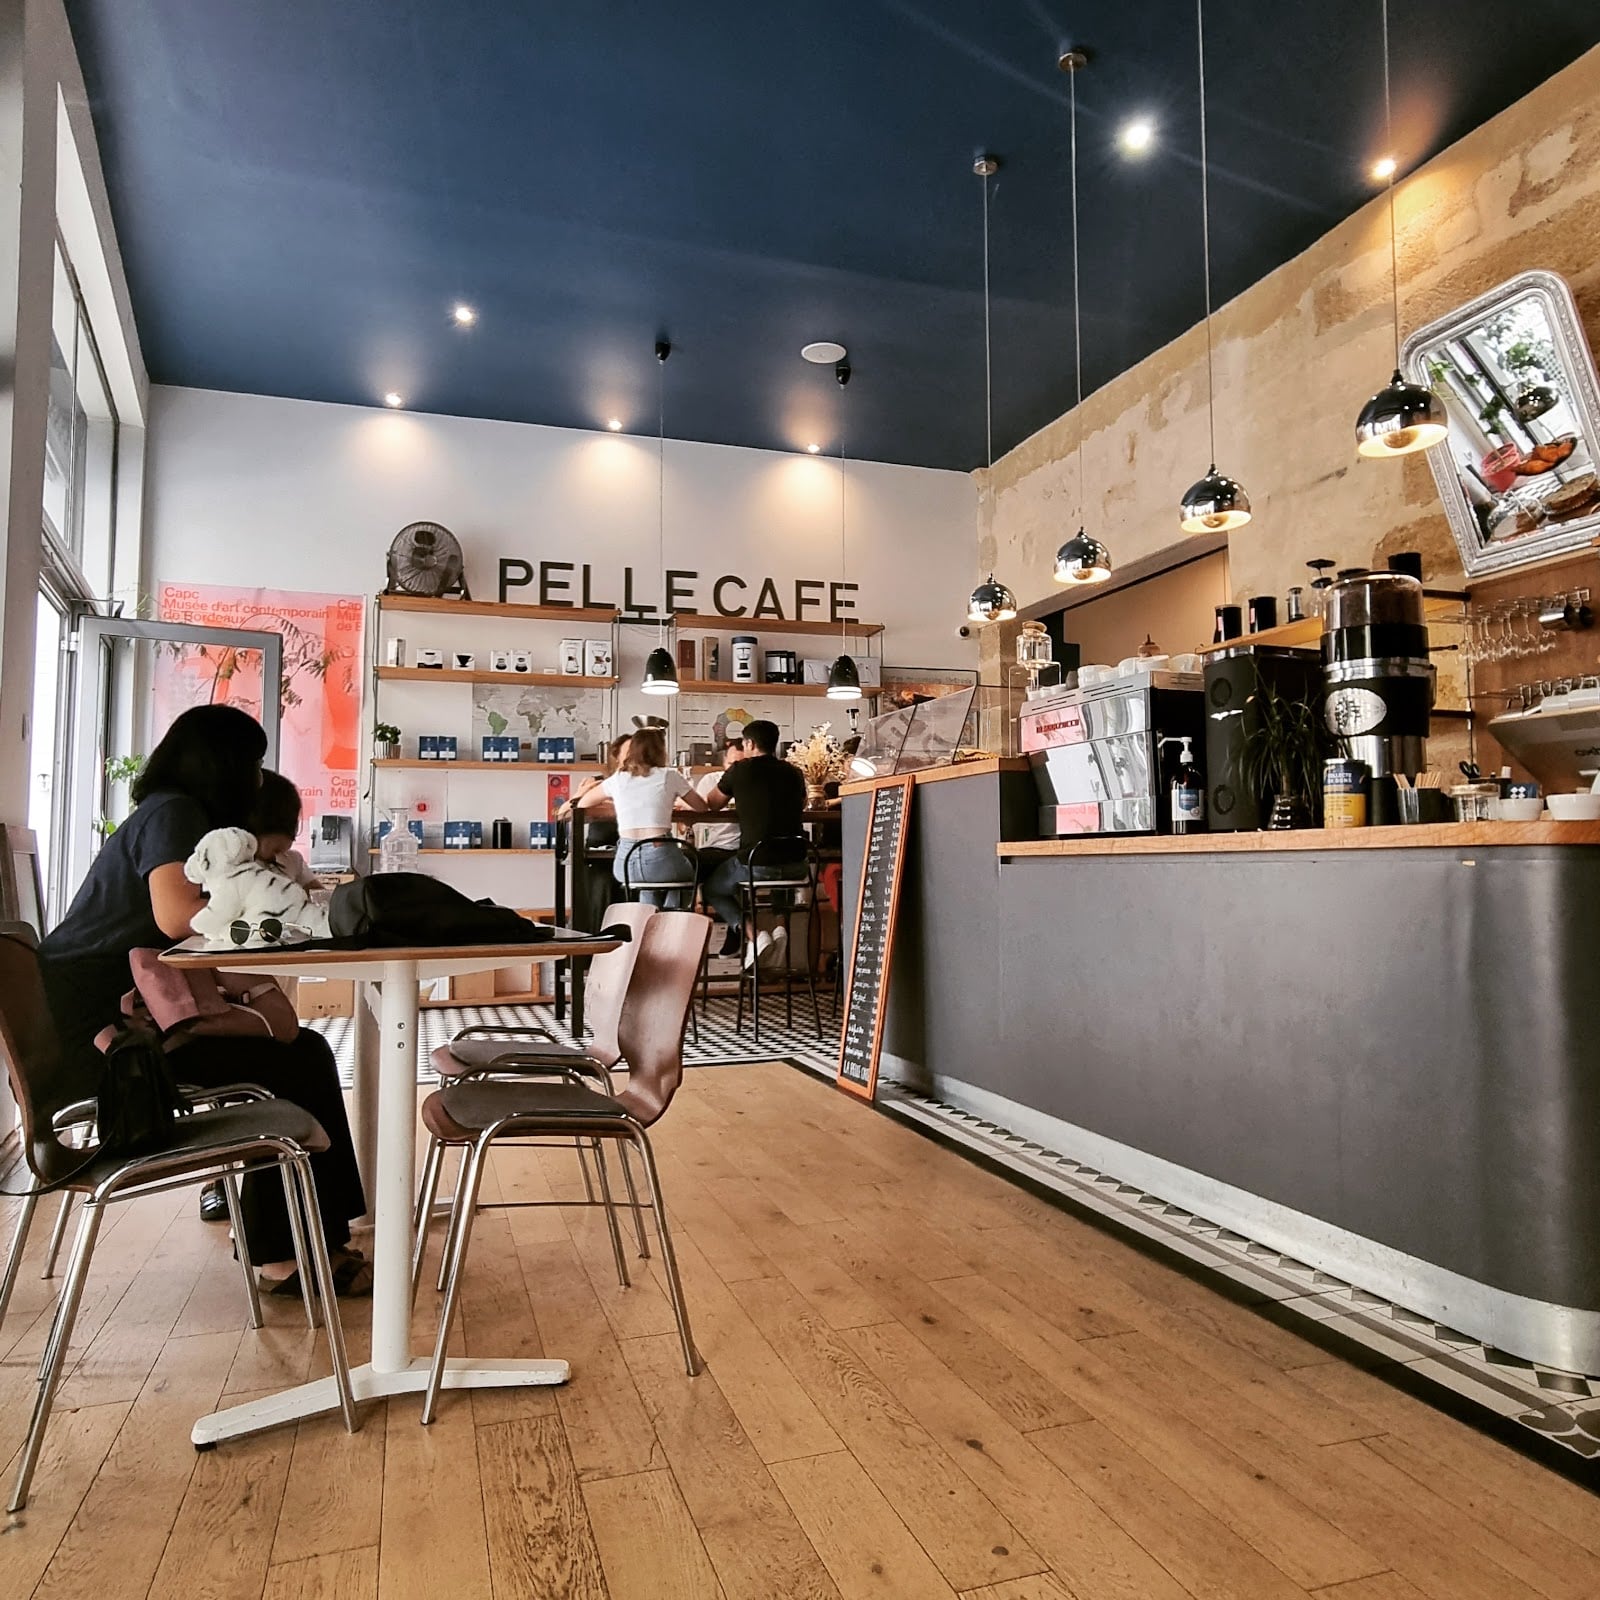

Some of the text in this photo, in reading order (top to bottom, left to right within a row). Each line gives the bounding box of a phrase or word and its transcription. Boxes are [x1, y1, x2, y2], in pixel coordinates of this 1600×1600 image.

[164, 586, 200, 600] Capc
[499, 558, 698, 614] PELLE
[713, 575, 859, 624] CAFE
[163, 598, 208, 611] Musée
[243, 604, 329, 618] contemporain
[163, 609, 246, 625] de Bordeaux
[331, 798, 346, 808] de
